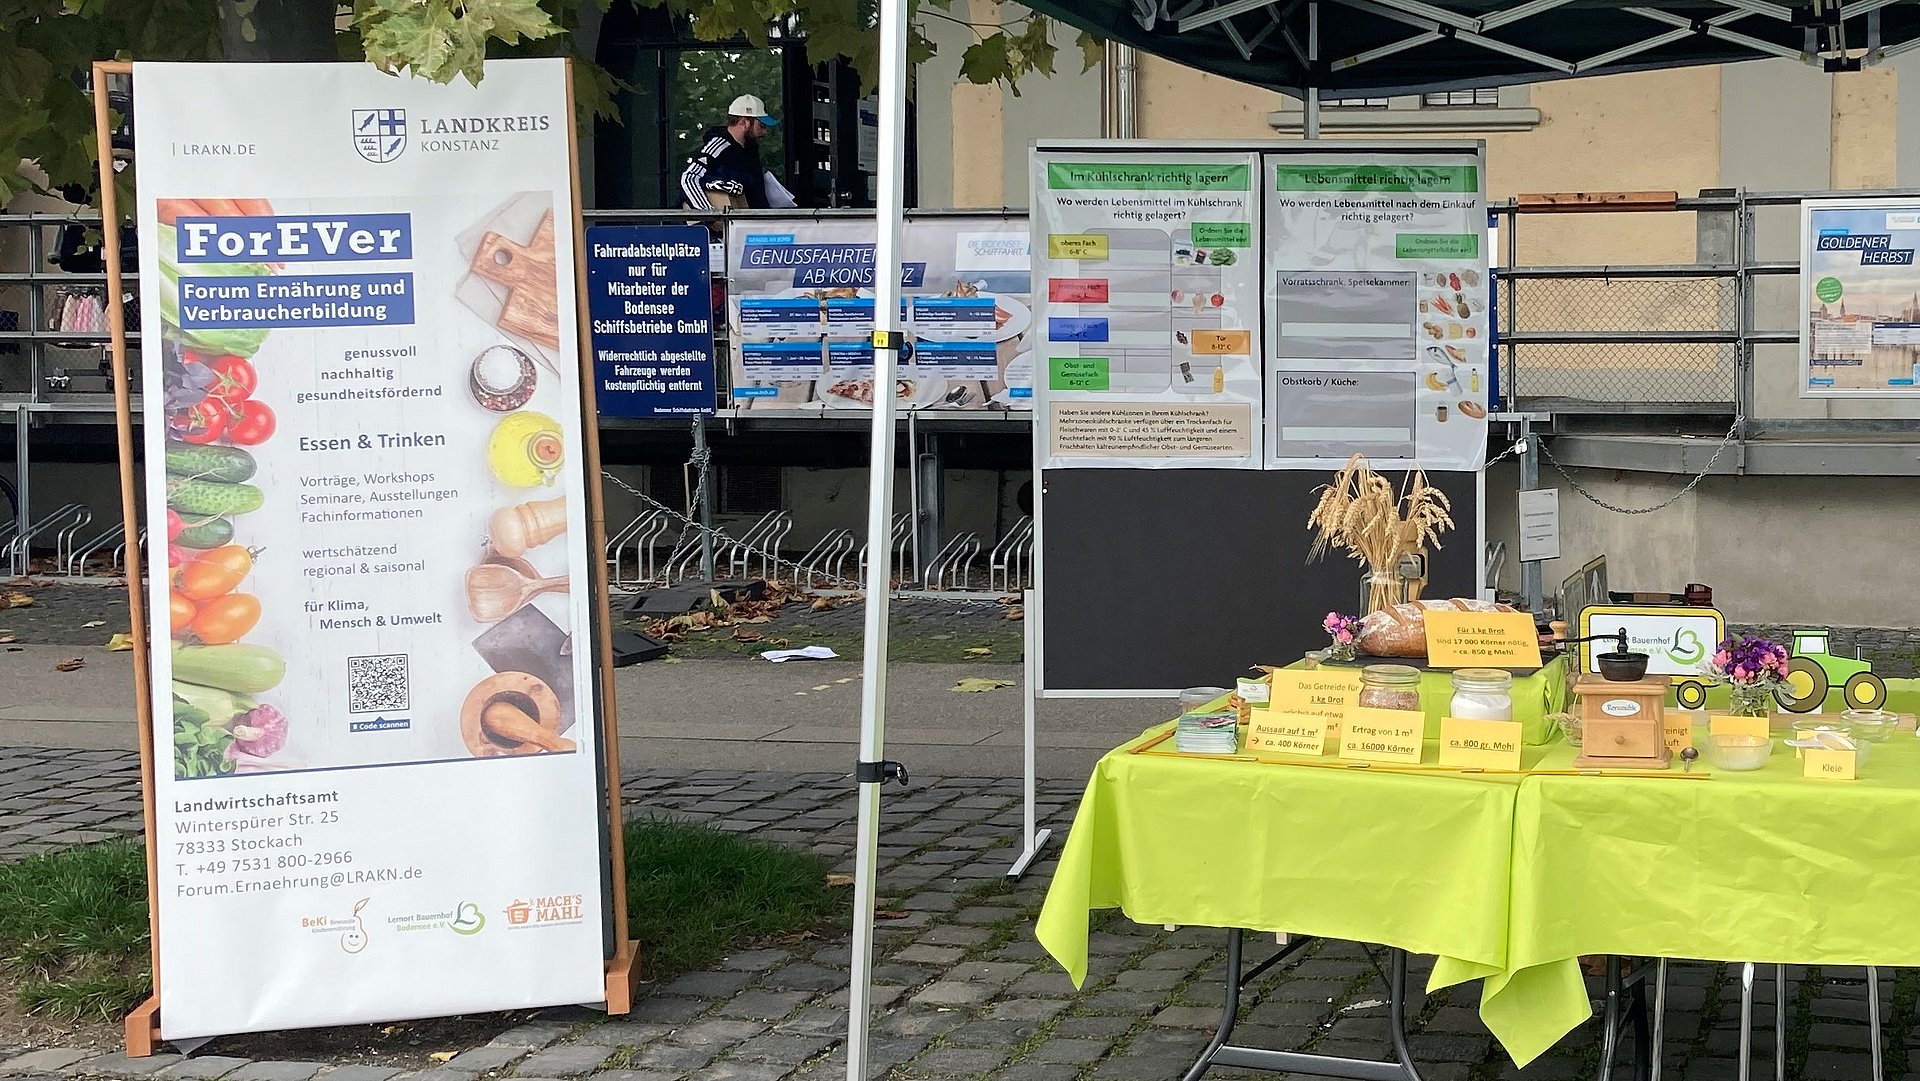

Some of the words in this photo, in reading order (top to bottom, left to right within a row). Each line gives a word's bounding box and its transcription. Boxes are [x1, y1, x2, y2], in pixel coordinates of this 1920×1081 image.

[421, 116, 549, 134] LANDKREIS
[183, 144, 256, 155] LRAKN.DE
[421, 138, 500, 152] KONSTANZ
[1071, 172, 1084, 181] Im
[1088, 171, 1152, 182] Kühlschrank
[1157, 172, 1192, 184] richtig
[1196, 173, 1228, 184] lagern
[1305, 173, 1377, 184] Lebensmittel
[1380, 174, 1414, 186] richtig
[1418, 175, 1450, 186] lagern
[1057, 198, 1072, 206] Wo
[1075, 198, 1108, 206] werden
[1111, 198, 1171, 206] Lebensmittel
[1174, 198, 1185, 206] im
[1188, 198, 1242, 208] Kühlschrank
[1280, 200, 1296, 208] Wo
[1298, 200, 1332, 208] werden
[1334, 200, 1394, 208] Lebensmittel
[1396, 200, 1418, 208] nach
[1420, 200, 1440, 208] dem
[1442, 200, 1476, 208] Einkauf
[1114, 211, 1142, 221] richtig
[1145, 212, 1186, 222] gelagert?
[1342, 214, 1371, 223] richtig
[1373, 213, 1414, 223] gelagert?
[184, 221, 402, 256] ForEVer
[1820, 236, 1888, 249] GOLDENER
[594, 244, 700, 260] Fahrradabstellplätze
[1863, 252, 1912, 263] HERBST
[628, 265, 646, 276] nur
[651, 262, 667, 276] für
[802, 268, 825, 284] AB
[184, 282, 250, 300] Forum
[257, 280, 361, 302] Ernährung
[368, 279, 404, 296] und
[608, 282, 666, 296] Mitarbeiter
[672, 282, 689, 296] der
[184, 301, 387, 323] Verbraucherbildung
[624, 301, 674, 314] Bodensee
[594, 320, 673, 334] Schiffsbetriebe
[677, 320, 708, 334] GmbH
[344, 346, 416, 362] genussvoll
[598, 350, 657, 362] Widerrechtlich
[660, 350, 706, 364] abgestellte
[321, 366, 394, 384] nachhaltig
[614, 365, 656, 378] Fahrzeuge
[660, 365, 690, 376] werden
[604, 380, 666, 393] kostenpflichtig
[668, 380, 702, 390] entfernt
[1282, 378, 1322, 386] Obstkorb
[1324, 378, 1329, 386] /
[1331, 378, 1358, 386] Küche:
[297, 385, 442, 404] gesundheitsfördernd
[300, 436, 351, 452] Essen
[358, 434, 372, 450] &
[377, 432, 446, 449] Trinken
[301, 474, 359, 492] Vorträge,
[364, 471, 434, 487] Workshops
[301, 491, 365, 507] Seminare,
[370, 487, 458, 504] Ausstellungen
[301, 506, 423, 523] Fachinformationen
[302, 542, 397, 560] wertschätzend
[304, 561, 355, 578] regional
[360, 562, 371, 574] &
[374, 559, 425, 574] saisonal
[304, 600, 324, 614] für
[328, 599, 369, 616] Klima,
[320, 615, 372, 630] Mensch
[376, 614, 386, 627] &
[390, 612, 442, 627] Umwelt
[1632, 636, 1670, 644] Bauernhof
[1298, 682, 1312, 690] Das
[1314, 682, 1346, 691] Getreide
[1348, 683, 1359, 692] für
[1316, 697, 1326, 705] kg
[380, 720, 408, 728] scannen
[1256, 724, 1286, 734] Aussaat
[1286, 727, 1300, 735] auf
[1308, 728, 1318, 736] m²
[1352, 726, 1376, 736] Ertrag
[1402, 728, 1414, 736] m²
[1278, 740, 1292, 748] 400
[1294, 740, 1320, 751] Körner
[1362, 742, 1386, 751] 16000
[1387, 744, 1414, 754] Körner
[1464, 740, 1478, 748] 800
[1480, 742, 1490, 750] gr.
[1493, 742, 1514, 751] Mehl
[1822, 764, 1842, 773] Kleie
[175, 790, 338, 813] Landwirtschaftsamt
[175, 815, 284, 836] Winterspürer
[289, 812, 314, 828] Str.
[320, 810, 338, 824] 25
[176, 838, 226, 856] 78333
[232, 834, 303, 852] Stockach
[176, 862, 188, 876] T.
[197, 860, 226, 874] +49
[232, 857, 271, 872] 7531
[277, 850, 353, 869] 800-2966
[176, 866, 422, 898] Forum.Ernaehrung@LRAKN.de
[302, 916, 327, 928] BeKi
[388, 914, 414, 924] Lernort
[416, 910, 453, 920] Bauernhof
[536, 908, 584, 922] MAHL
[397, 922, 431, 932] Bodensee
